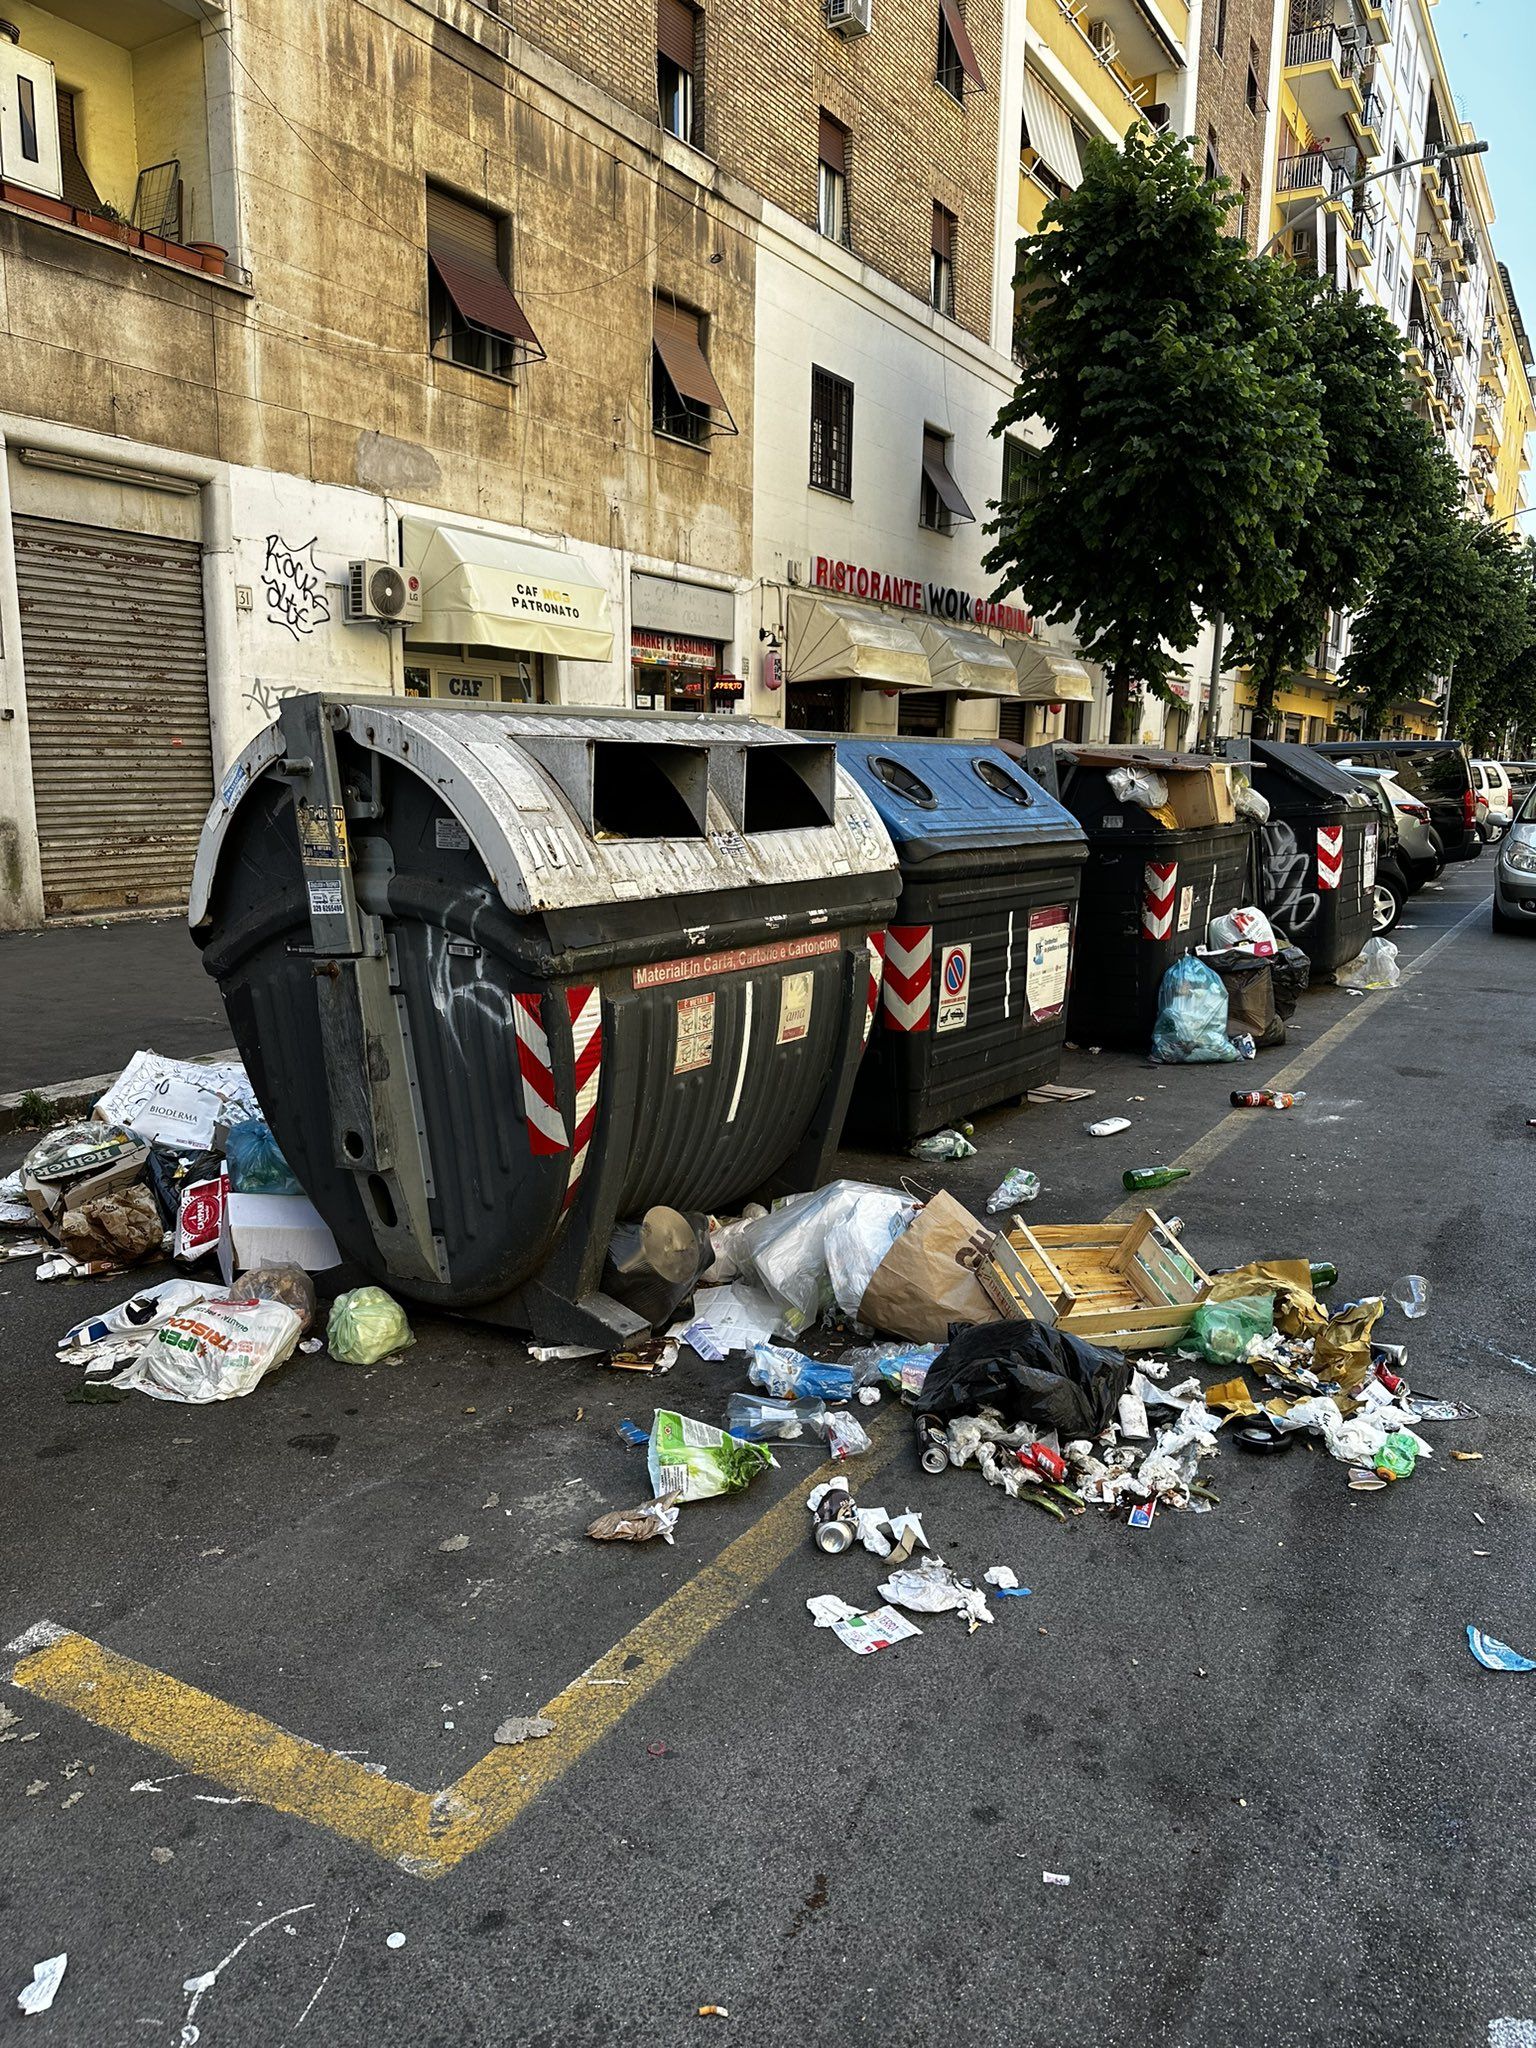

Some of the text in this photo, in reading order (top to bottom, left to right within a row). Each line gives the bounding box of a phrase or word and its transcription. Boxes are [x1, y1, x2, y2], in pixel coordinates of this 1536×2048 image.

[238, 590, 249, 605] 31
[409, 593, 418, 602] LG
[516, 583, 538, 597] CAF
[816, 556, 1034, 633] RISTORANTE WOK GIARDINO
[511, 596, 580, 618] PATRONATO
[449, 678, 482, 697] CAF
[713, 682, 743, 690] APERTO
[636, 961, 688, 985] Materiali
[703, 955, 736, 971] Carta,
[738, 948, 778, 966] Cartone
[780, 947, 786, 958] e
[788, 937, 838, 956] Cartoncino
[785, 1009, 805, 1023] ama
[149, 1105, 198, 1123] BIODERMA
[32, 1148, 113, 1178] Heinek
[158, 1328, 198, 1353] IPER
